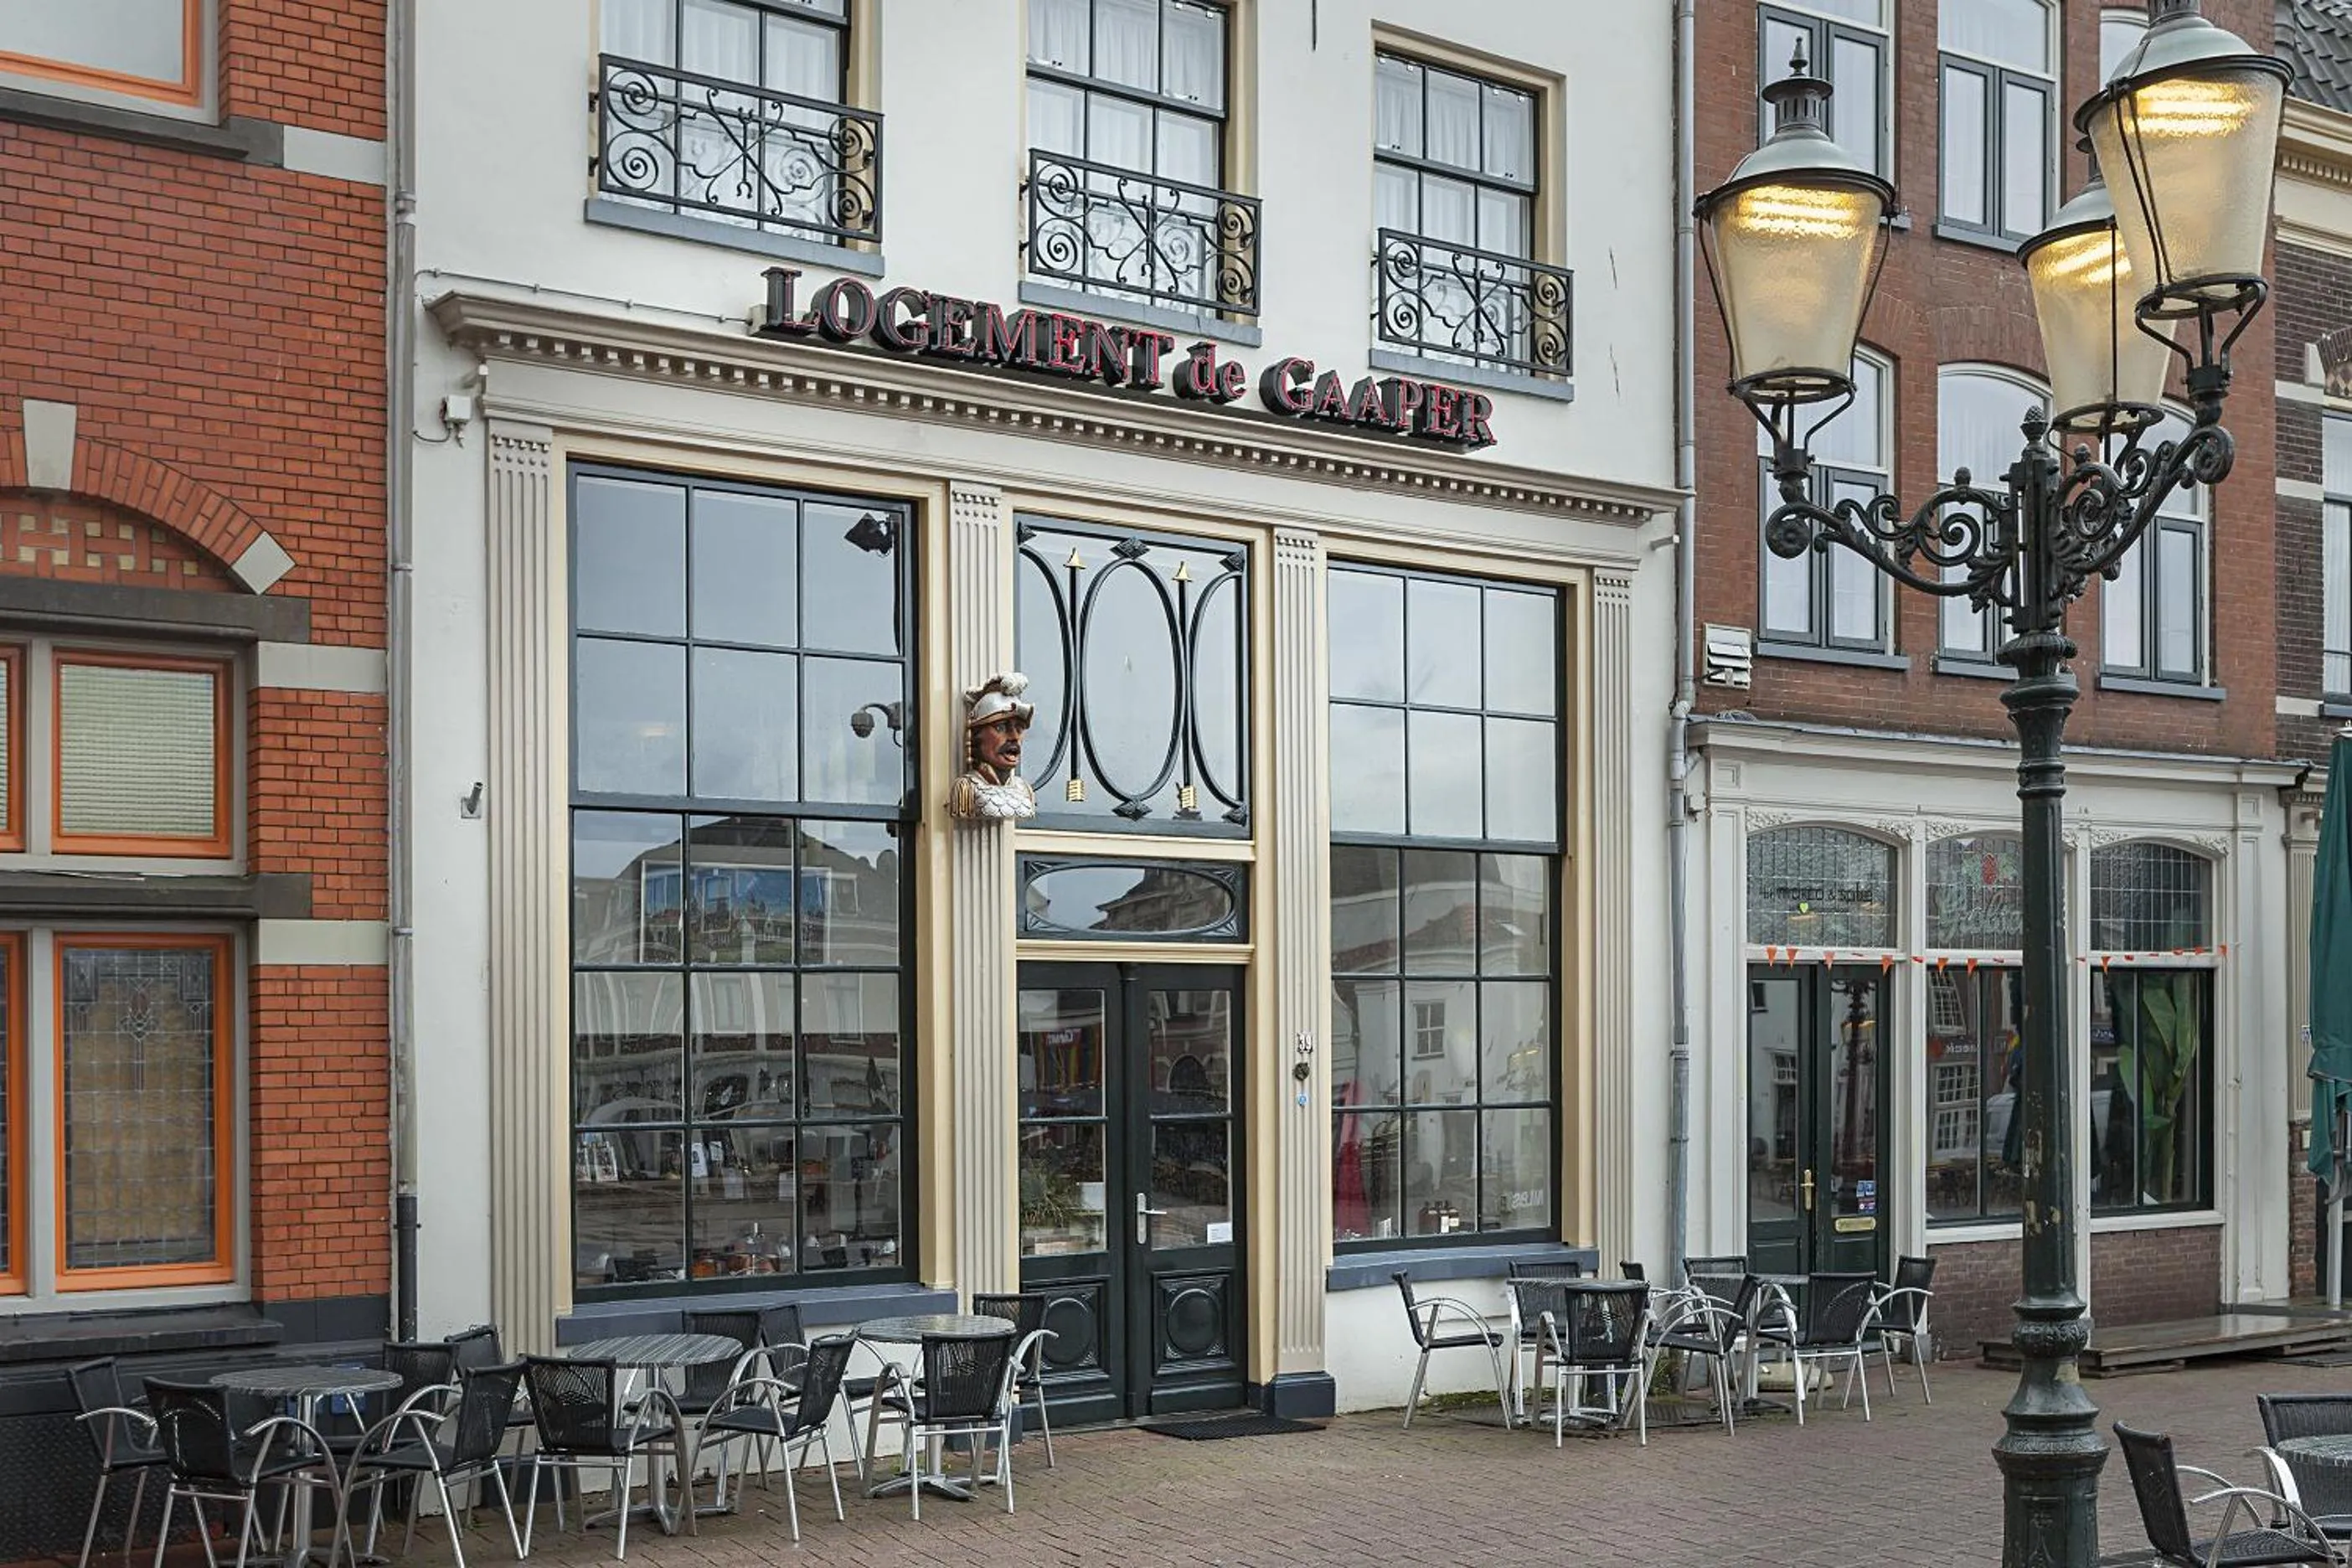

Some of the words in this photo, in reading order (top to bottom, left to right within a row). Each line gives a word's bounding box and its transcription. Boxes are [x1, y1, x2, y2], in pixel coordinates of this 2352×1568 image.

[761, 266, 1175, 390] LOGEMENT
[1173, 340, 1247, 405] de
[1259, 356, 1498, 448] GAAPER
[1298, 1034, 1313, 1051] 39
